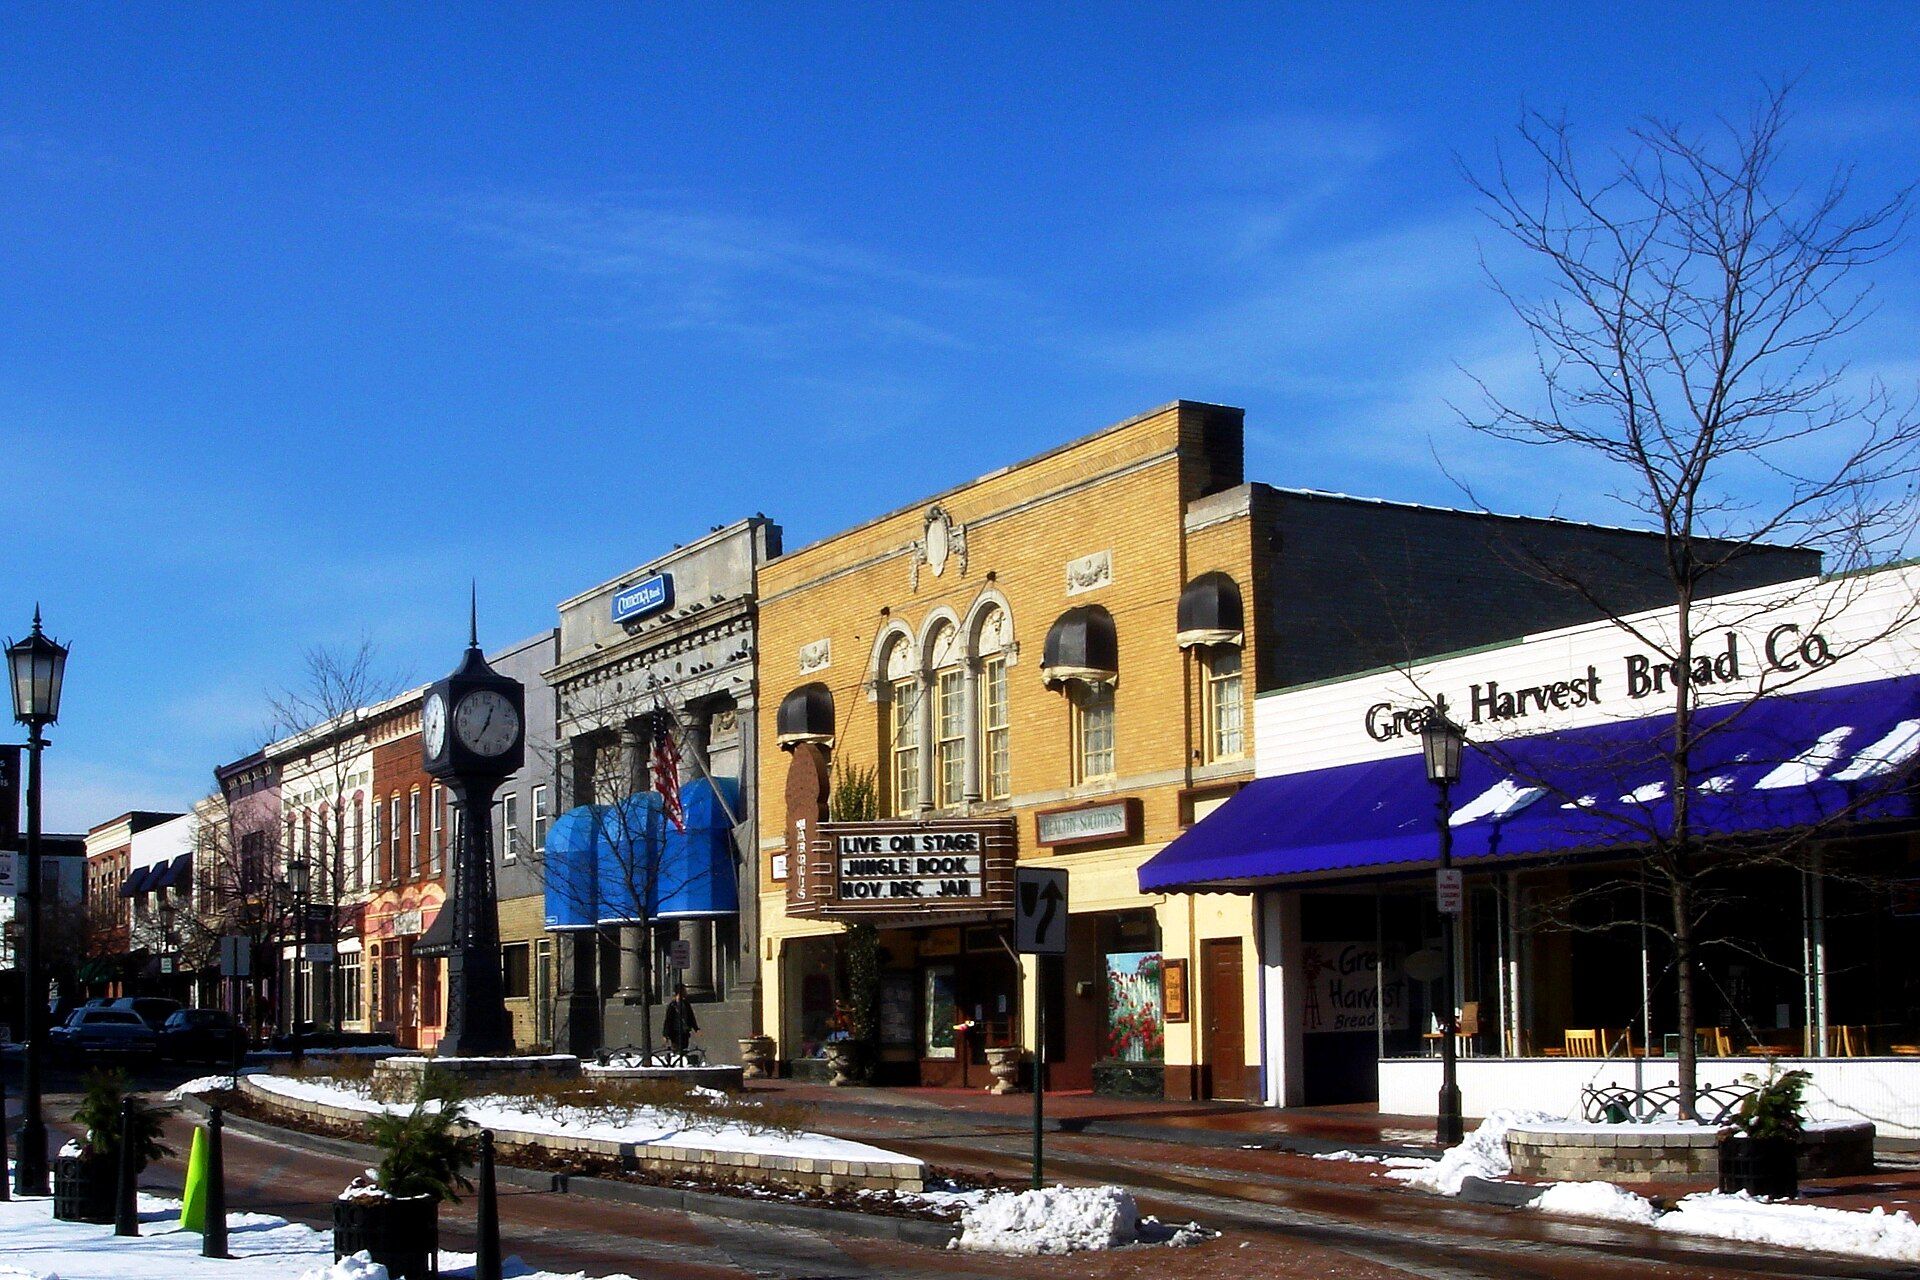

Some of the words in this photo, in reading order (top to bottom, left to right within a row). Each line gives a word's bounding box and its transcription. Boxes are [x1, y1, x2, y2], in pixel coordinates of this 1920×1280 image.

[1469, 665, 1602, 725] Harvest
[843, 836, 881, 853] LIVE
[889, 835, 914, 851] ON
[922, 834, 977, 851] STAGE
[796, 818, 806, 899] MARQUIS
[844, 858, 910, 875] JUNGLE
[917, 857, 968, 874] BOOK
[936, 879, 970, 896] JAN
